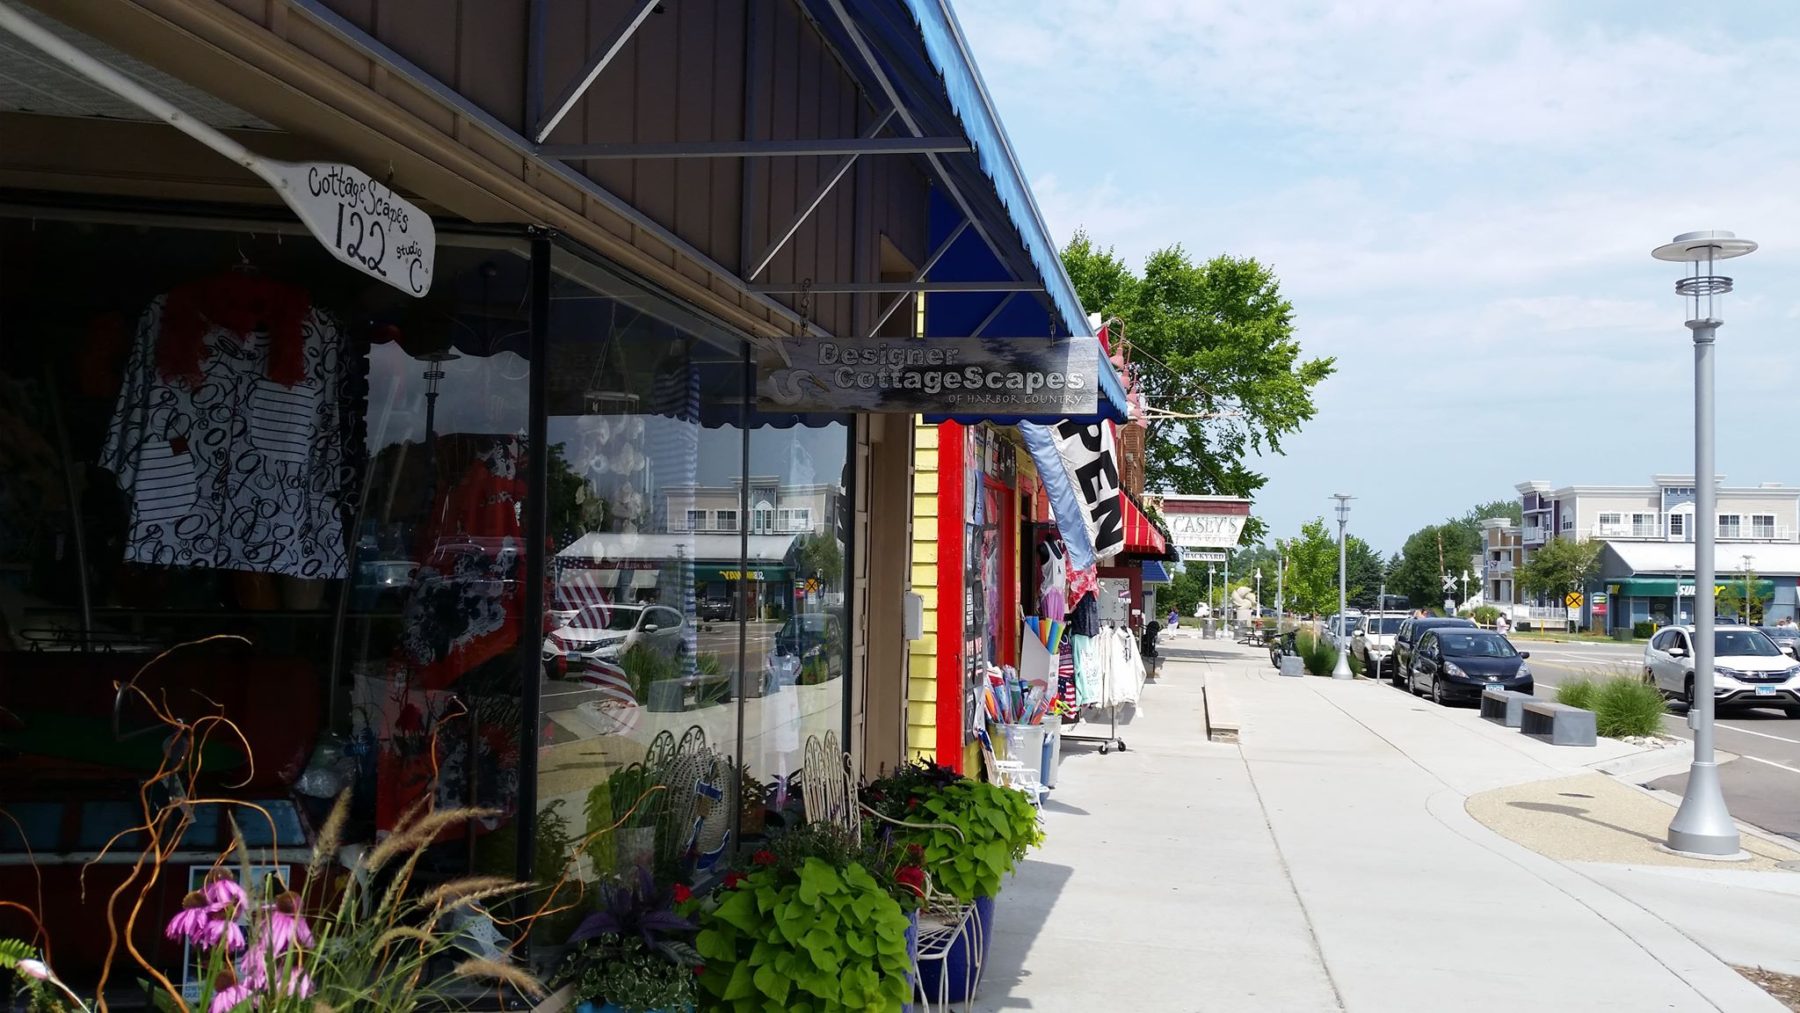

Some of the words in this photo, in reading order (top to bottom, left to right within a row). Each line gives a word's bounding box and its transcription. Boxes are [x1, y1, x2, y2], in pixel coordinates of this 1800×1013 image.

[335, 201, 387, 277] 122
[396, 240, 423, 260] studio
[409, 257, 423, 294] C
[818, 342, 959, 370] Designer
[834, 365, 1086, 395] CottageScapes
[948, 394, 961, 404] OF
[967, 394, 1020, 405] HARBOR
[1024, 394, 1083, 406] COUNTRY
[1057, 420, 1124, 551] PEN
[1173, 515, 1238, 534] CASEY'S
[1185, 552, 1225, 560] BACKYARD
[1675, 584, 1727, 597] SUY
